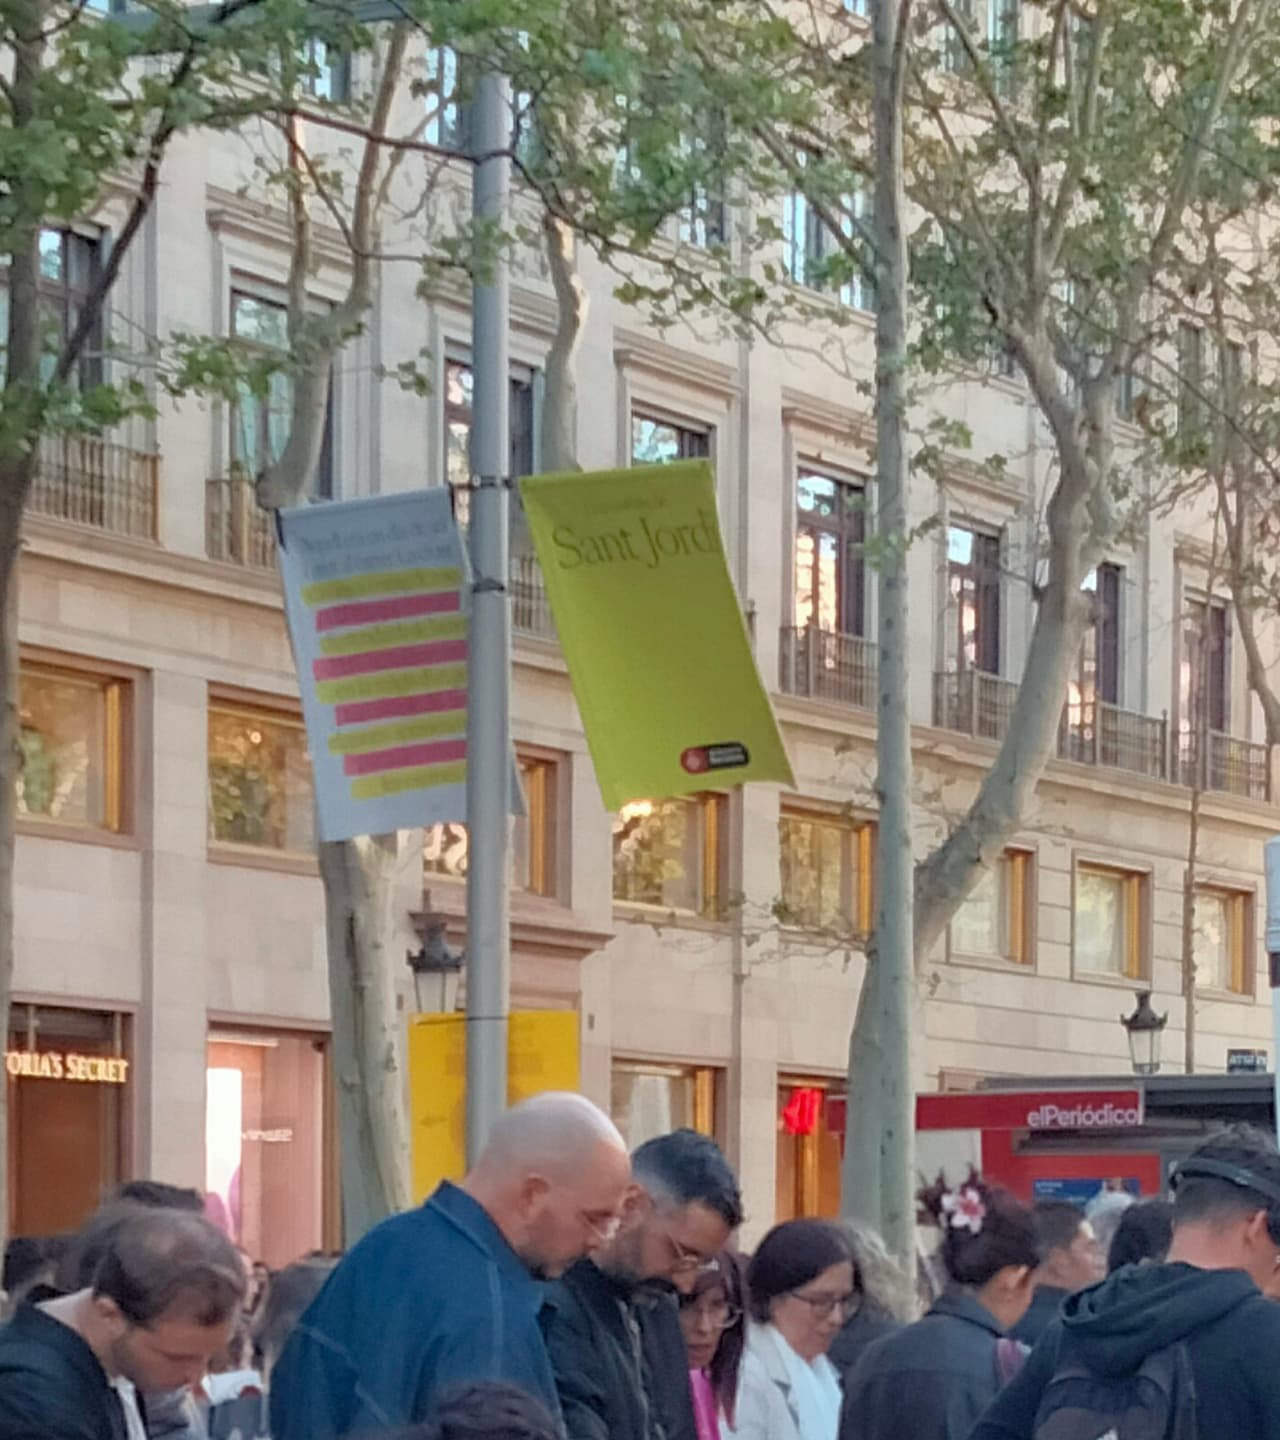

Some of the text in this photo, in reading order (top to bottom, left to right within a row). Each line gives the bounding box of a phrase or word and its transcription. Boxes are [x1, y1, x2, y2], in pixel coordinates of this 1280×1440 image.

[552, 524, 640, 570] Sant
[4, 1051, 129, 1082] ORIA'S SECRET
